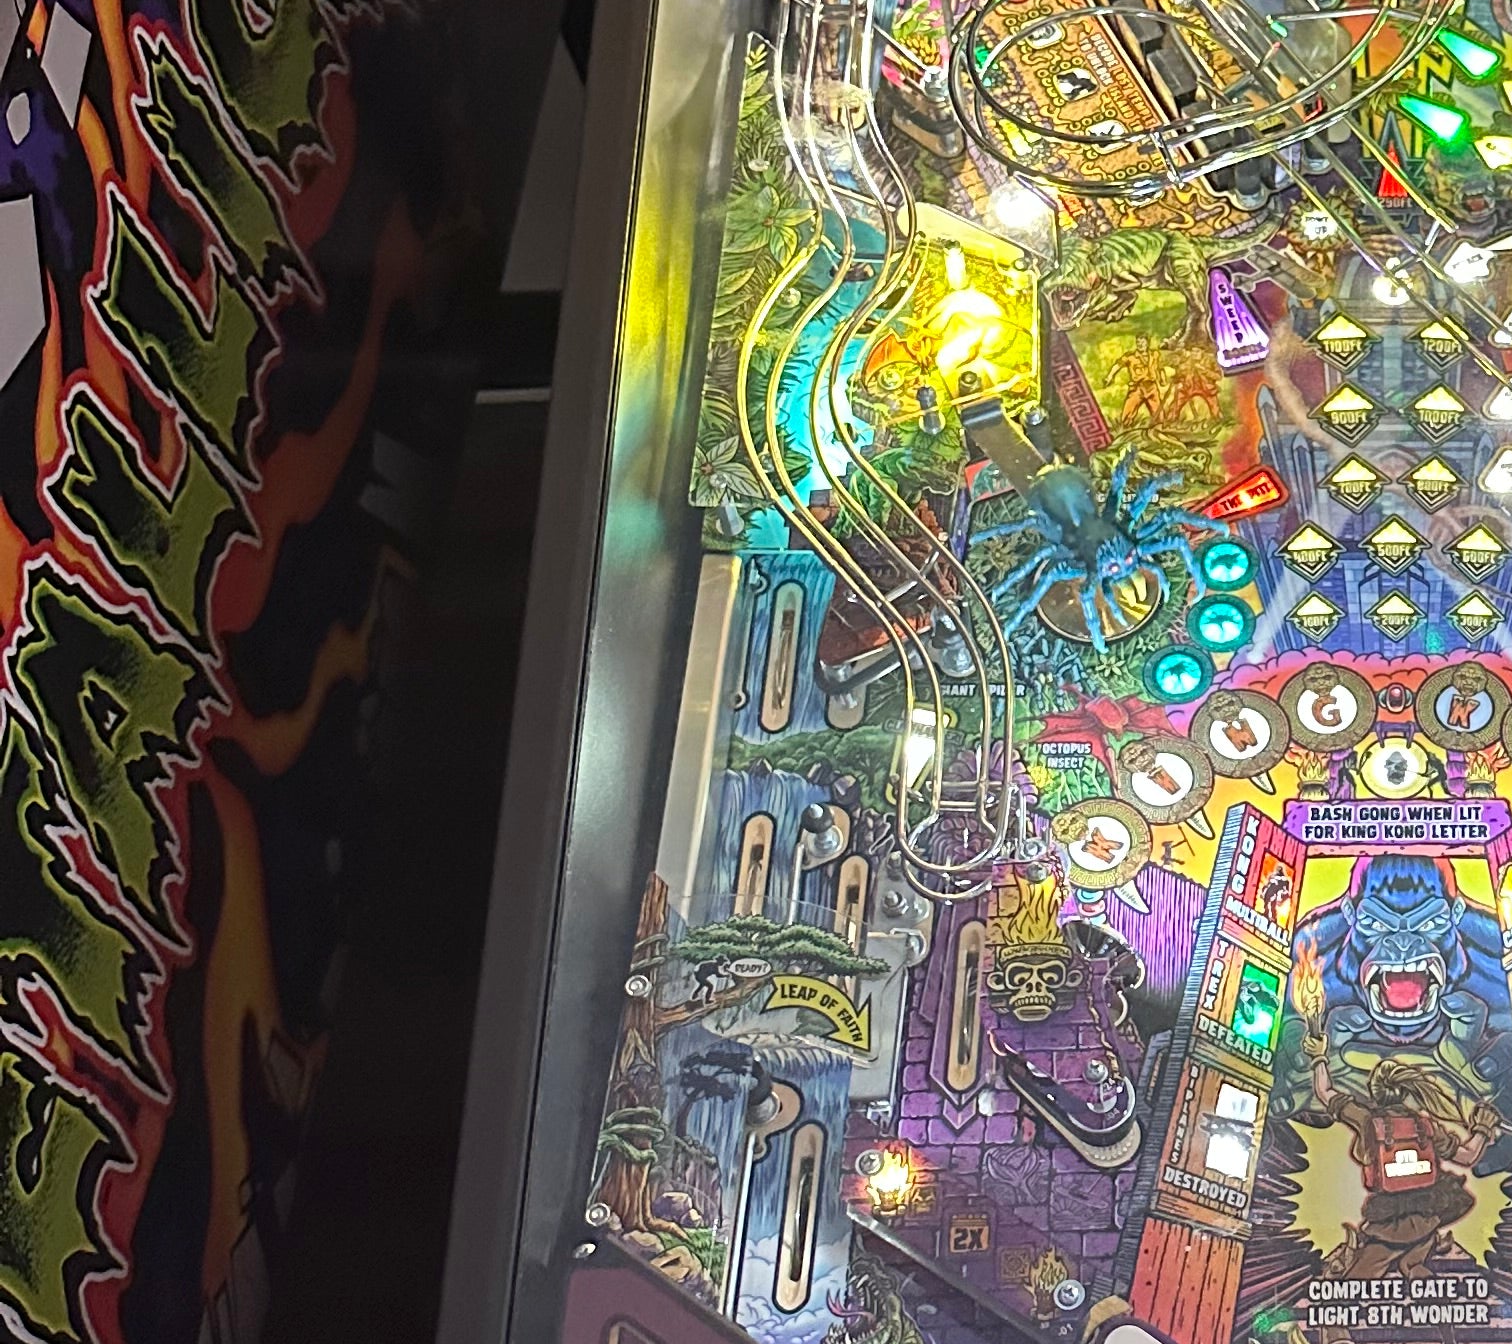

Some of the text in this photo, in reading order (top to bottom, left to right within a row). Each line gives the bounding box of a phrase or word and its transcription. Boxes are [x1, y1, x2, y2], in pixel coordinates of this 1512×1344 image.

[1079, 37, 1136, 119] TO UNLOCK ISLAND
[1091, 32, 1118, 68] DECODE
[1112, 67, 1135, 91] LOST
[1128, 90, 1157, 127] TEMPLE
[1218, 284, 1244, 343] SWEEP
[1042, 743, 1091, 756] OCTOPUS
[1047, 756, 1084, 769] INSECT
[1081, 828, 1123, 864] K
[1221, 719, 1259, 753] N
[1311, 694, 1342, 726] G
[1447, 694, 1477, 730] K
[1304, 823, 1488, 840] FOR KING KONG LETTER
[1310, 805, 1481, 823] BASH GONG WHEN LIT
[1231, 815, 1260, 895] KONG
[1225, 895, 1289, 948] MULTIBALL
[735, 963, 769, 973] READY?
[780, 984, 863, 1043] LEAP OF FAITH
[1198, 1014, 1273, 1066] DEFEATED
[1171, 1064, 1199, 1163] BIPLANES
[1164, 1167, 1246, 1208] DESTROYED
[953, 1230, 986, 1252] 2X
[1308, 1278, 1489, 1301] COMPLETE GATE TO
[1308, 1303, 1489, 1327] LIGHT 8TH WONDER
